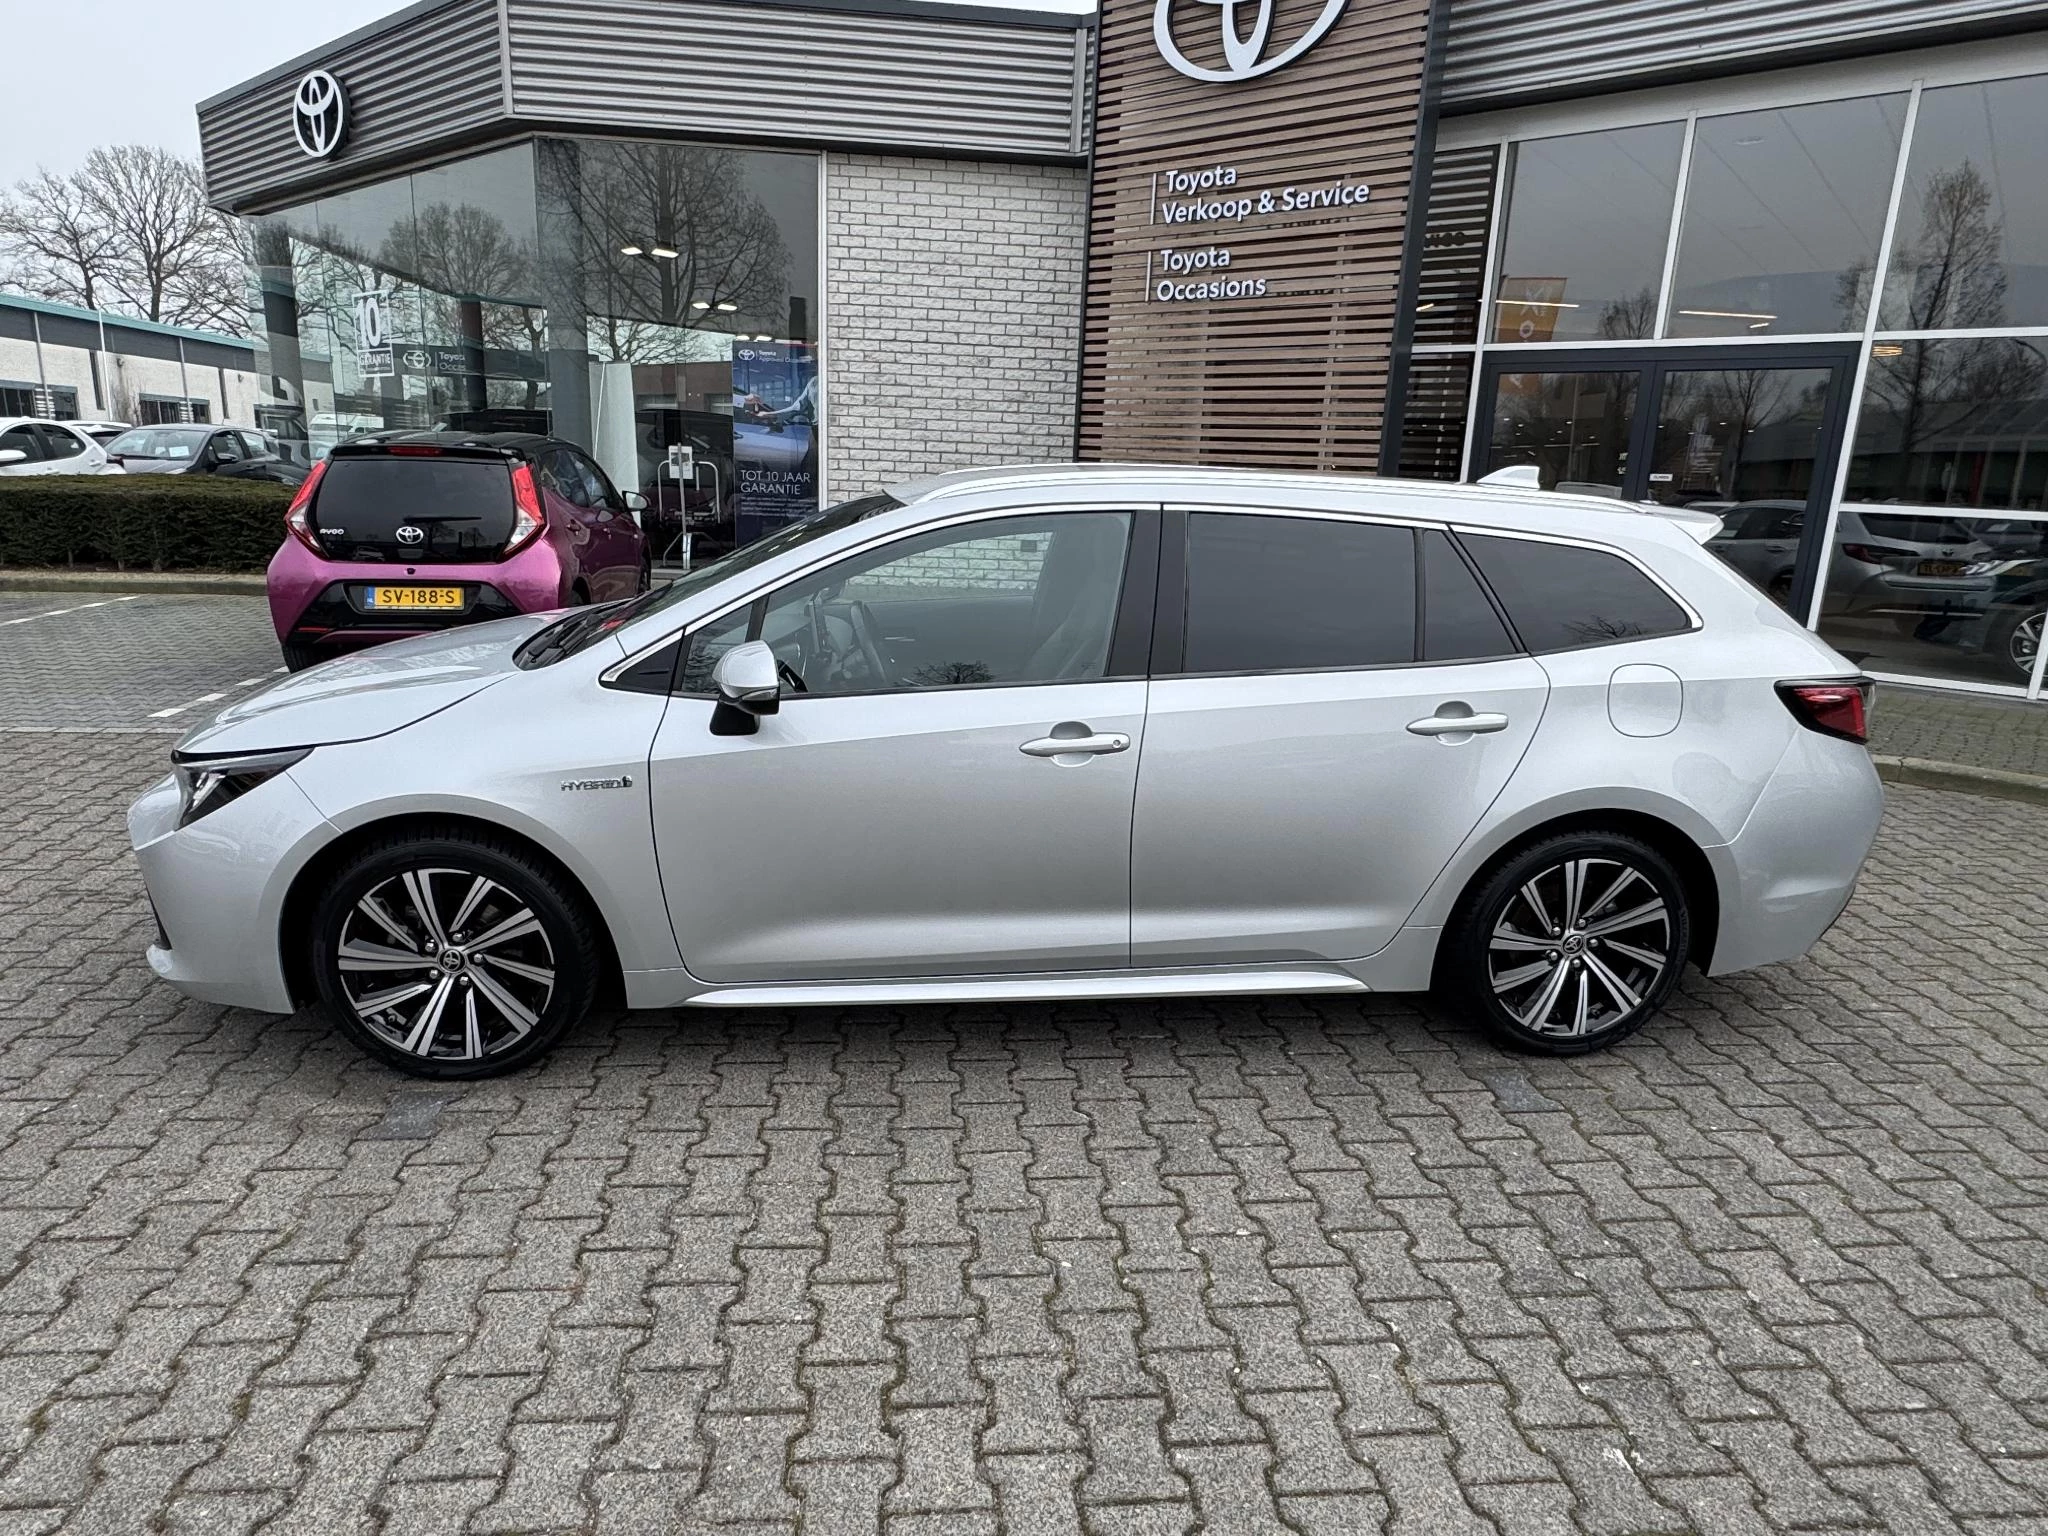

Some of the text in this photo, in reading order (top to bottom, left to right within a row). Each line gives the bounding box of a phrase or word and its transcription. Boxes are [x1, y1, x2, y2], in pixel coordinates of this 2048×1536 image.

[1166, 165, 1237, 195] Toyota
[1162, 181, 1369, 224] Verkoop & Service
[1160, 246, 1230, 274] Toyota
[1156, 275, 1267, 301] Occasions
[741, 469, 811, 483] TOT 10 JAAR
[740, 482, 801, 495] GARANTIE
[382, 589, 455, 604] SV-188-S
[560, 778, 622, 791] HYBRID
